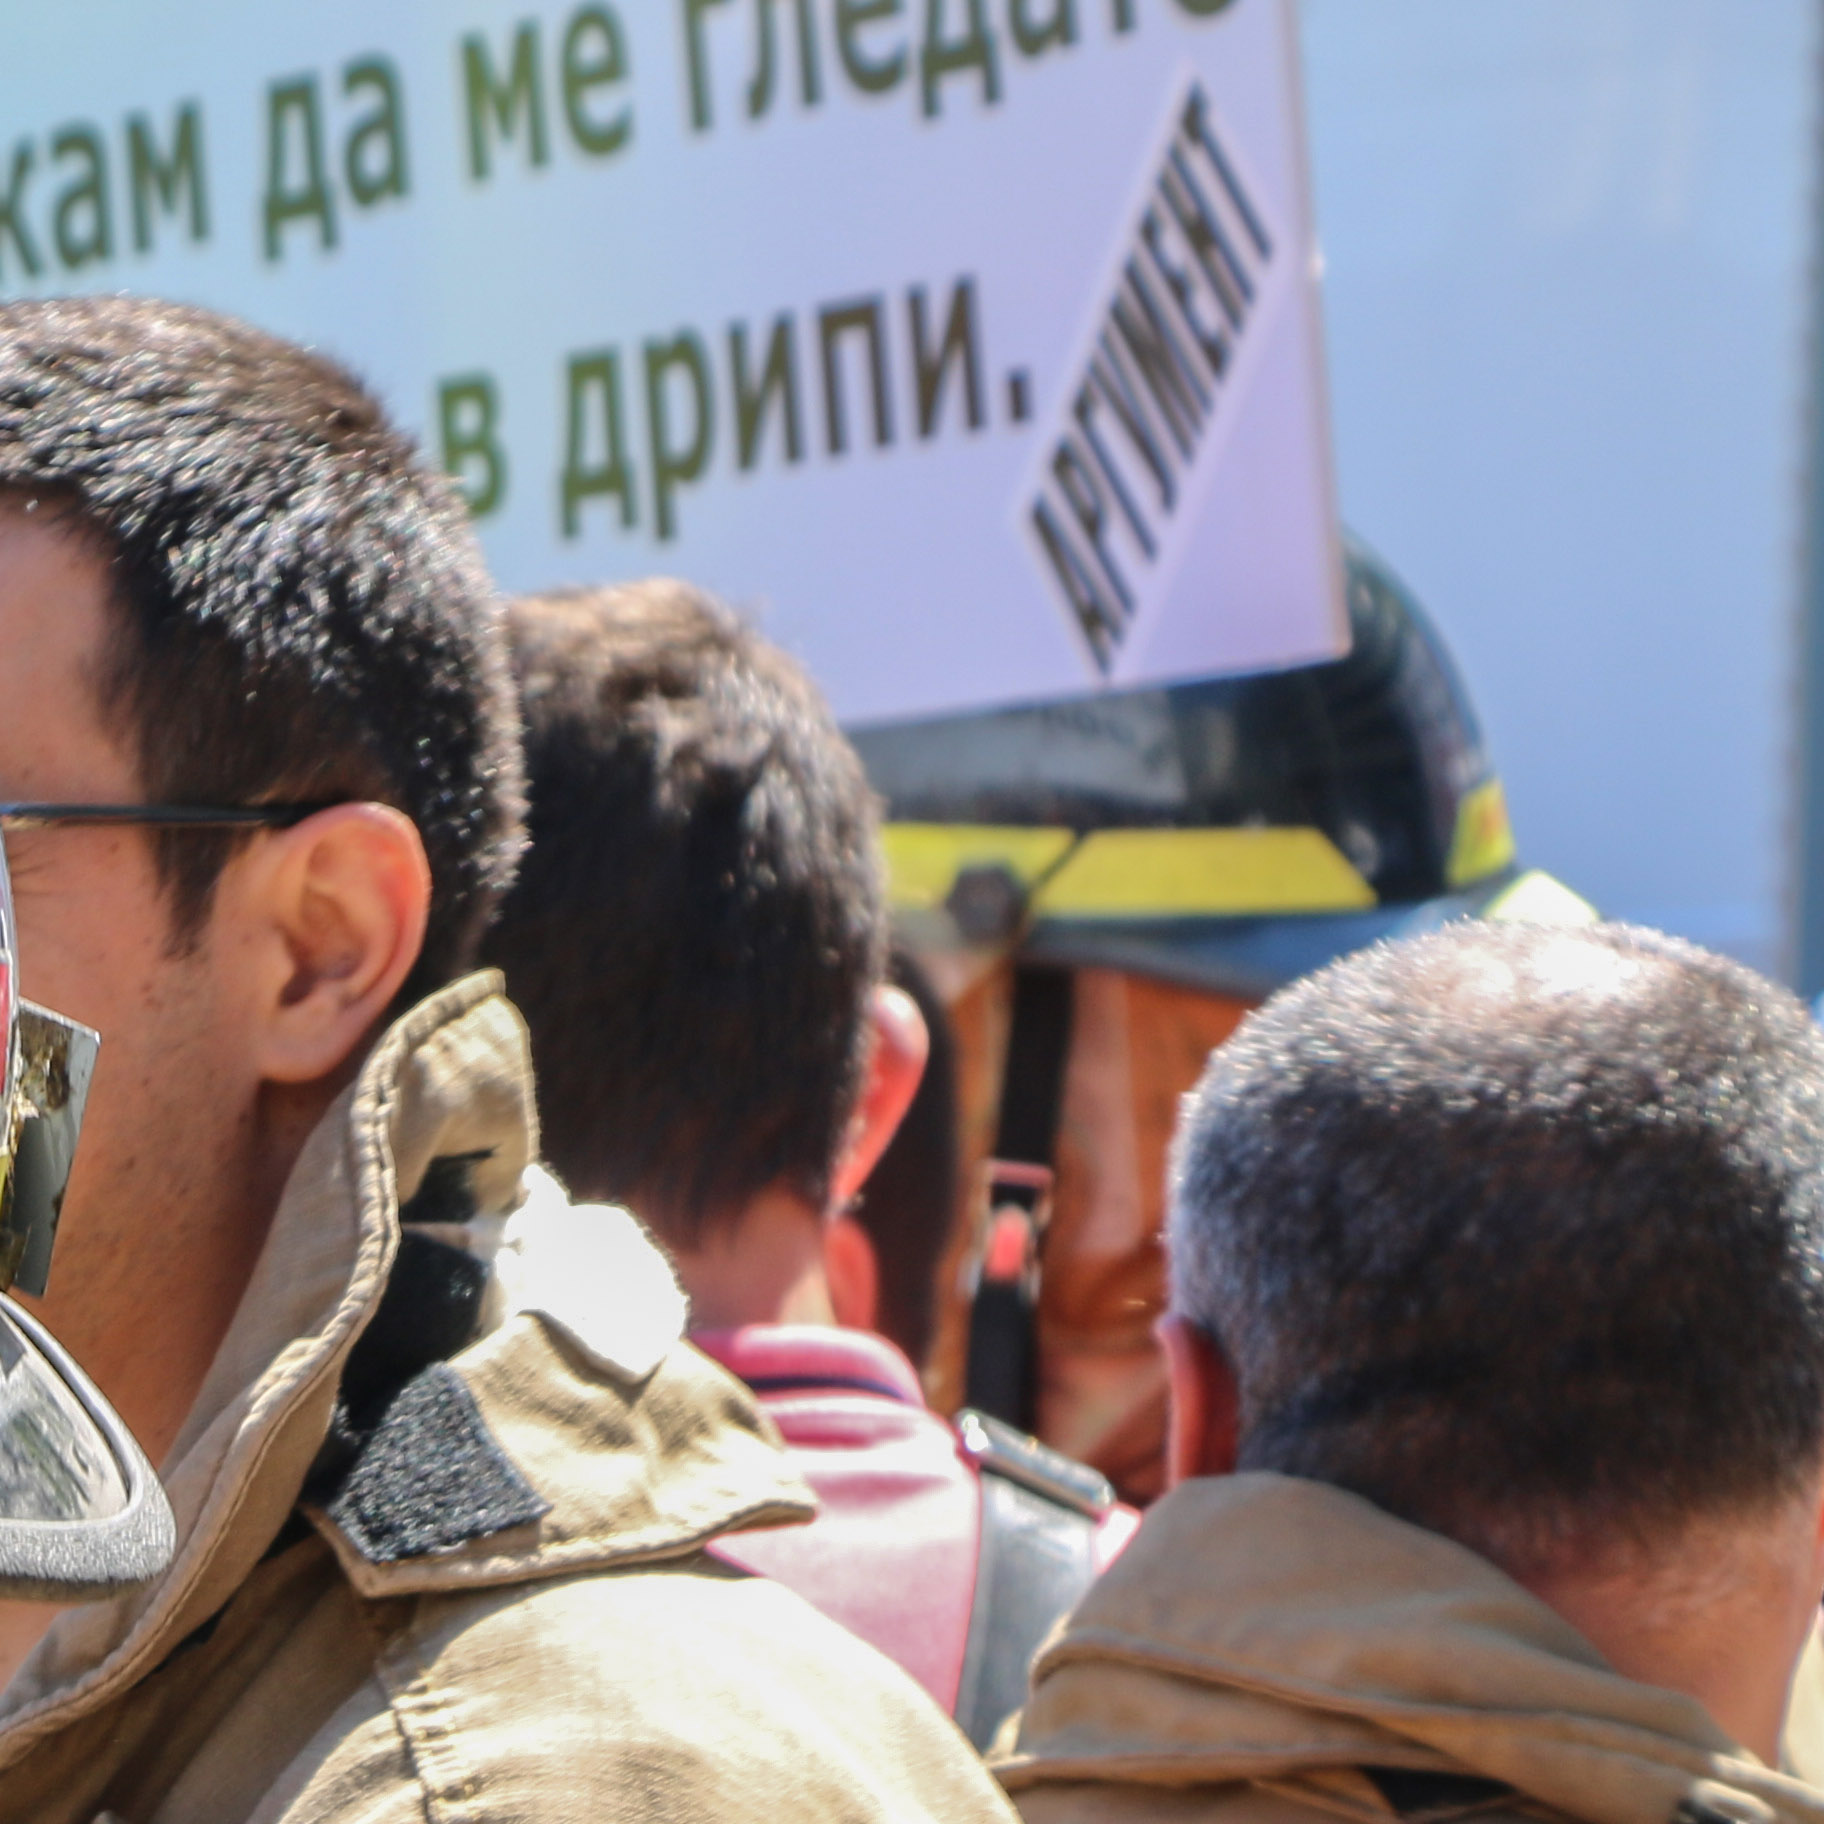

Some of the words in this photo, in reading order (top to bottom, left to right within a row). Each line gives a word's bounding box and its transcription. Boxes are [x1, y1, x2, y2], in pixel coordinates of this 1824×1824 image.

[260, 50, 412, 264] да
[459, 0, 633, 182] ме
[682, 0, 1240, 131] глед
[435, 371, 509, 521] в
[558, 273, 1034, 543] дрипи.
[1029, 78, 1273, 677] АРГУМЕНТ
